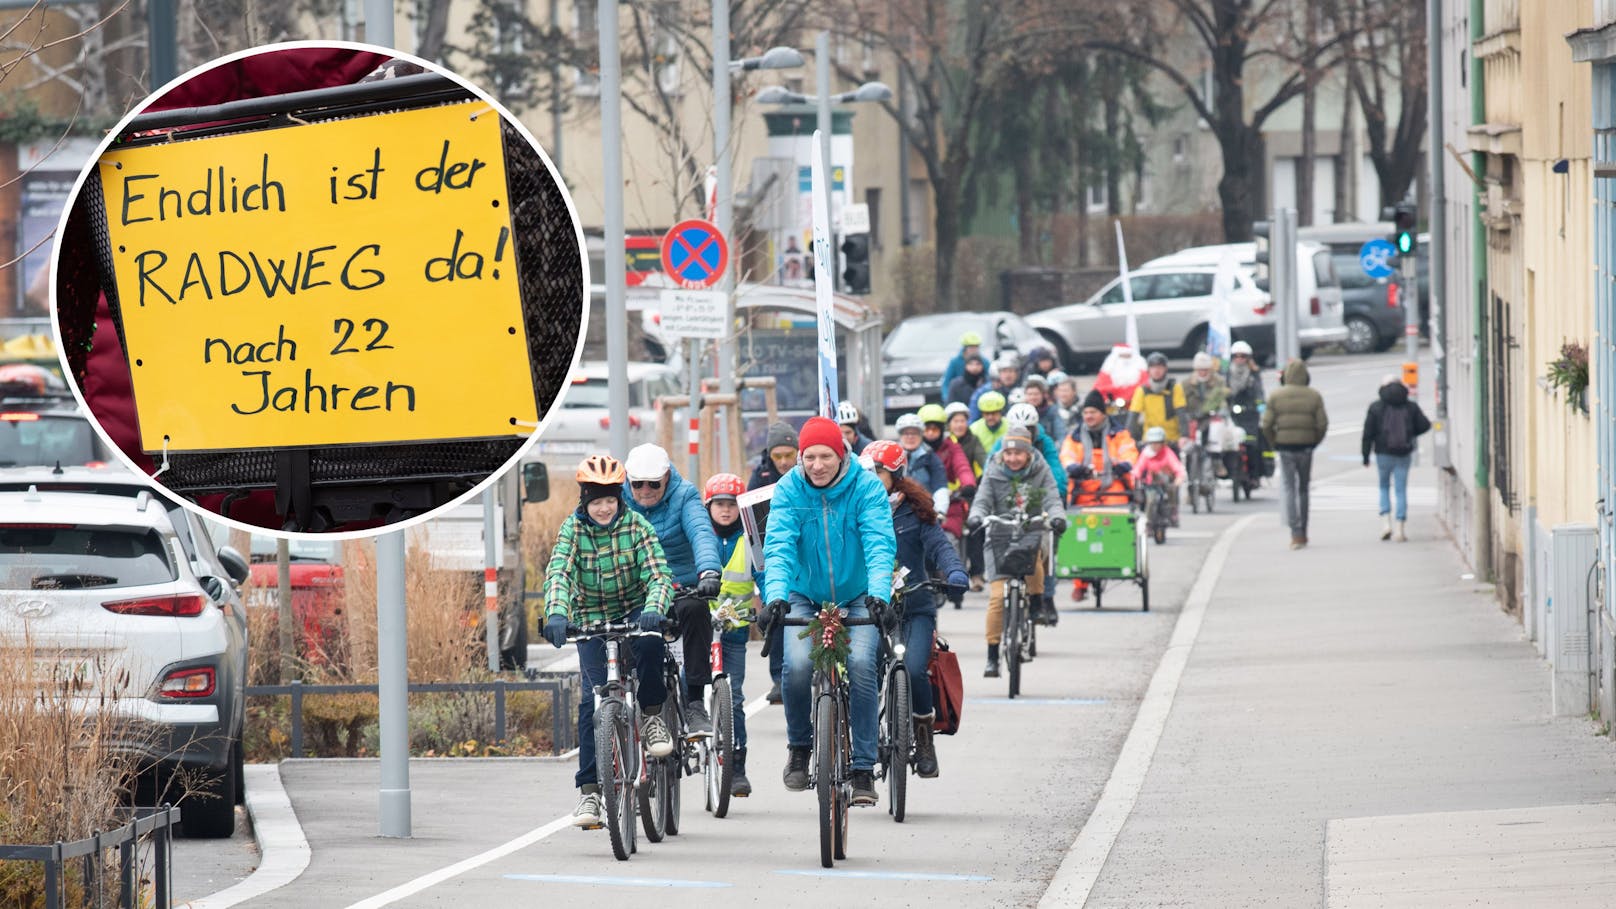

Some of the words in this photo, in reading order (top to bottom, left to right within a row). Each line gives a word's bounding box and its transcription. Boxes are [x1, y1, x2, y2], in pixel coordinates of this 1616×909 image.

[120, 153, 286, 227] Endlich
[330, 147, 385, 205] ist
[415, 139, 487, 195] der
[134, 244, 385, 307] RADWEG
[424, 226, 510, 283] da!
[204, 324, 297, 365] nach
[330, 318, 395, 356] 22
[231, 368, 416, 415] Jahren
